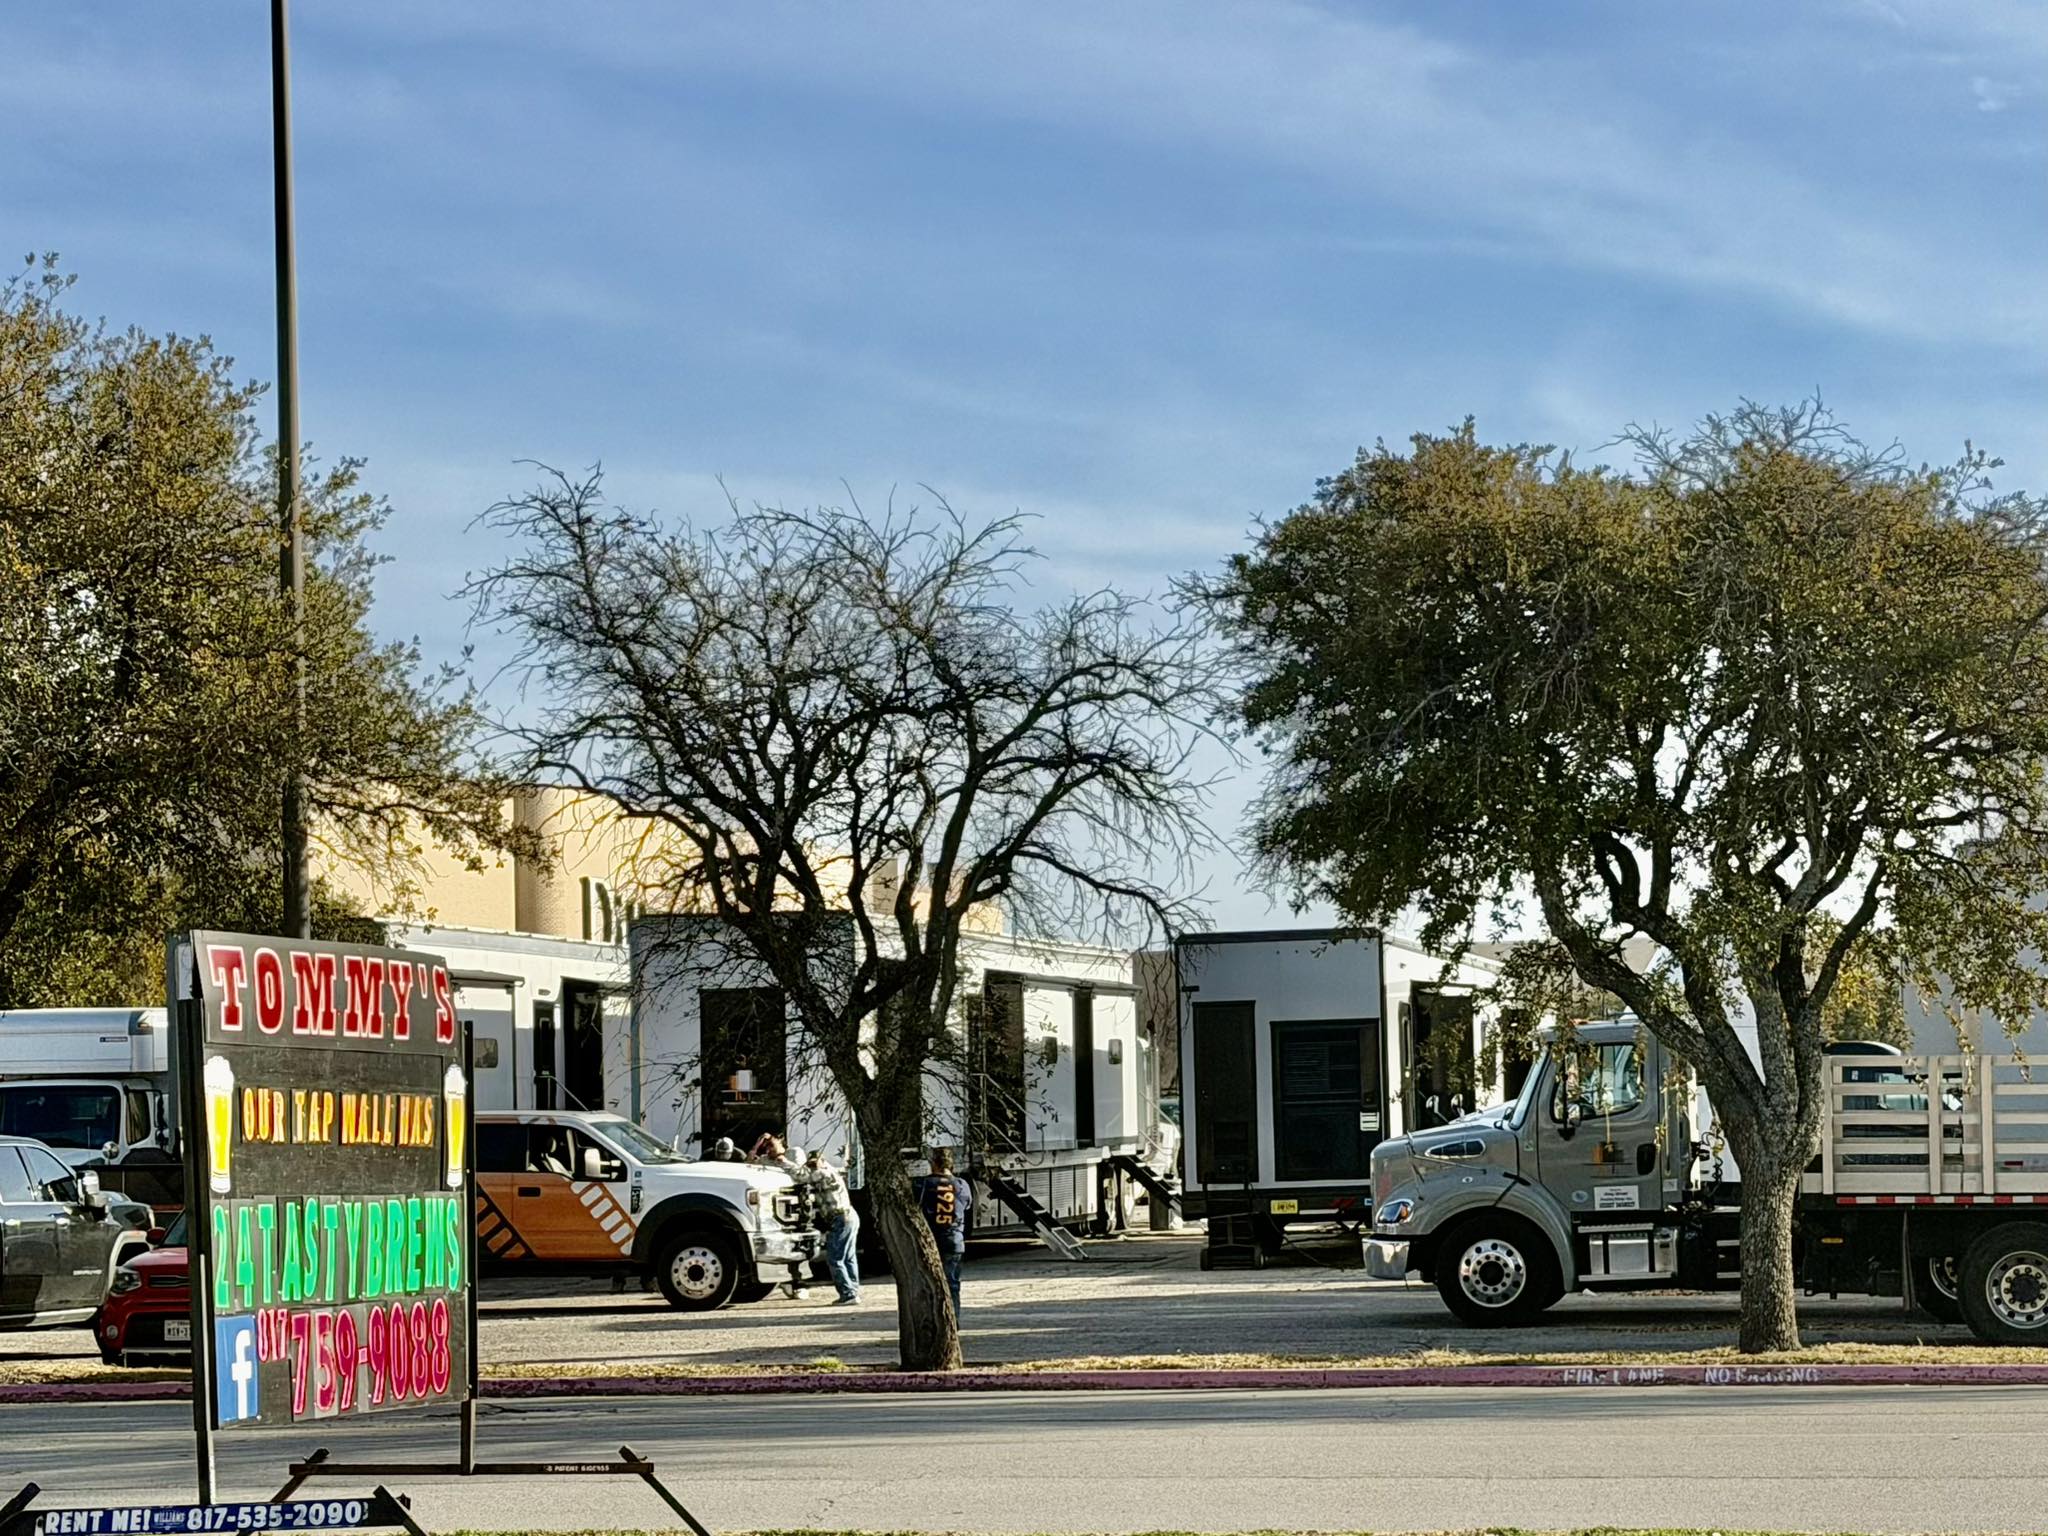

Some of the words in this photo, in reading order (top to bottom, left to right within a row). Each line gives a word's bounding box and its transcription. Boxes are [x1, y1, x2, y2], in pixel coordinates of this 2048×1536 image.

[206, 944, 455, 1044] TOMMY'S
[243, 1087, 286, 1143] OUR
[293, 1090, 335, 1143] TAP
[341, 1092, 393, 1145] WALL
[398, 1095, 434, 1146] HAS
[935, 1184, 955, 1225] 1925
[1704, 1367, 1731, 1383] NO
[1735, 1367, 1819, 1383] PING
[45, 1511, 104, 1534] RENT
[111, 1509, 151, 1533] ME!
[186, 1501, 363, 1531] 817-535-2090
